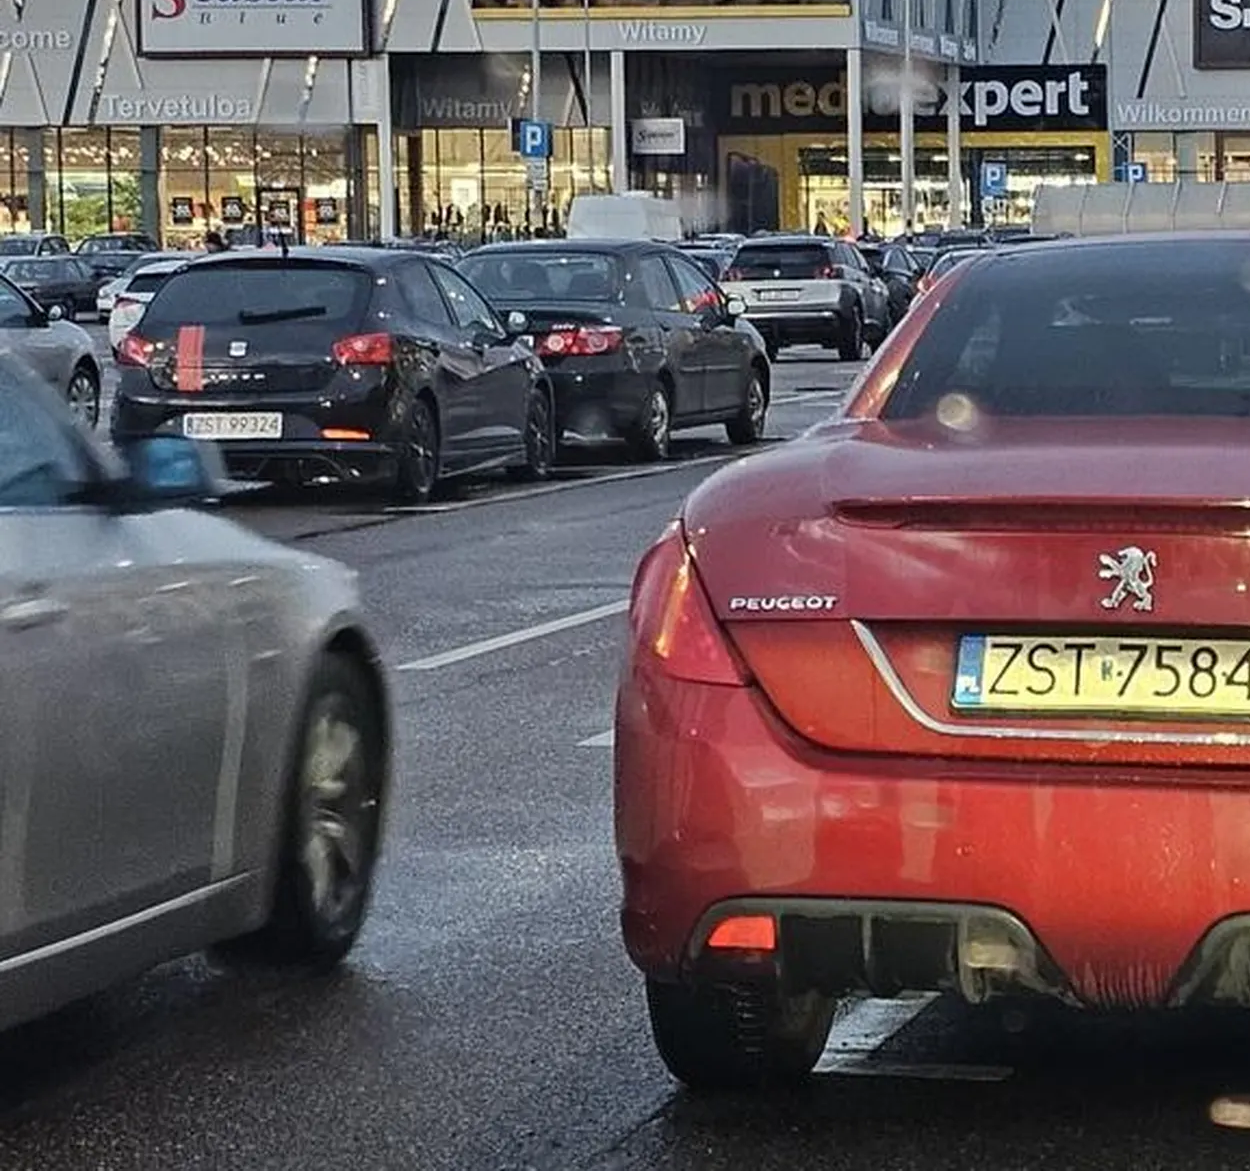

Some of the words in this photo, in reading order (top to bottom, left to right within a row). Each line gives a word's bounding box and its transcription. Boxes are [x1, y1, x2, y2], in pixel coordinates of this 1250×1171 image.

[618, 20, 709, 47] Witamy
[102, 94, 251, 118] Tervetuloa
[422, 97, 513, 122] Witamy
[526, 125, 542, 154] P
[986, 165, 1001, 187] P
[730, 596, 837, 610] PEUGEOT
[987, 643, 1096, 696] ZST
